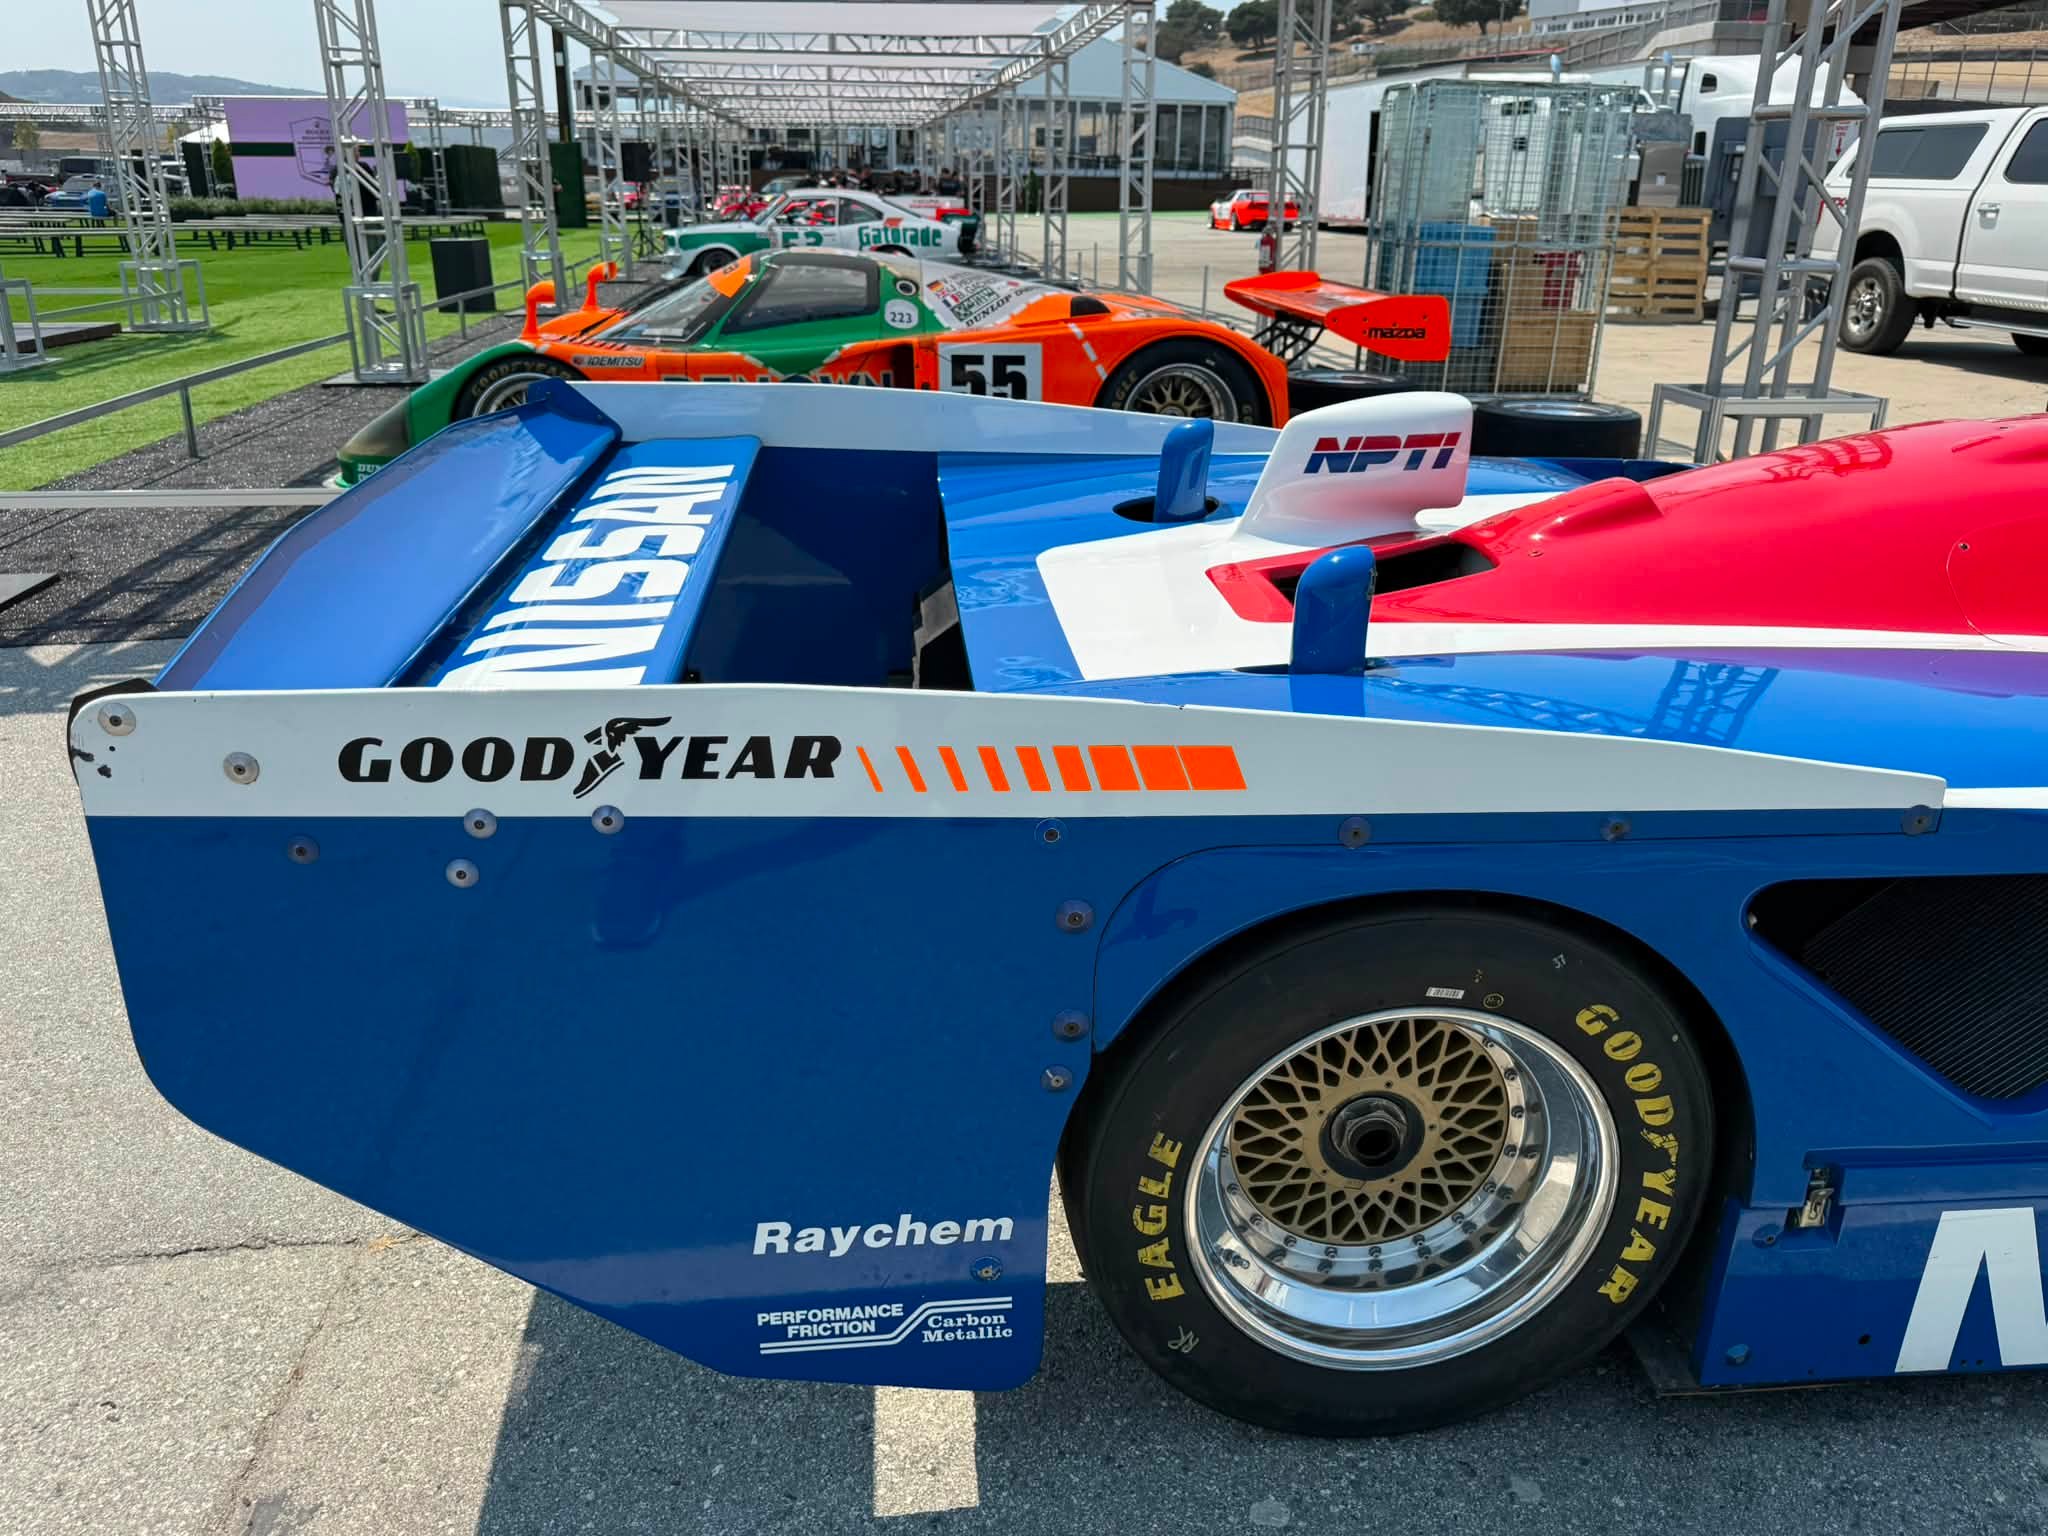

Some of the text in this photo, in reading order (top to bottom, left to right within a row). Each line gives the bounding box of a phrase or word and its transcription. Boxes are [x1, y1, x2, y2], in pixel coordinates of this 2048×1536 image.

[858, 226, 942, 251] Gatorade
[890, 311, 912, 324] 223
[1368, 327, 1426, 339] mazda
[587, 356, 644, 367] IDEMITSU
[951, 354, 1028, 400] 55
[1303, 432, 1462, 474] NPTI
[436, 464, 735, 689] NISSAN
[338, 735, 842, 785] GOODYEAR
[1575, 1004, 1679, 1304] GOODYEAR
[1131, 1131, 1185, 1301] EAGLE
[752, 1213, 1014, 1258] Raychem
[757, 1303, 904, 1326] PERFORMANCE
[926, 1313, 1007, 1329] Carbon
[787, 1319, 876, 1339] FRICTION
[921, 1327, 1013, 1343] Metallic
